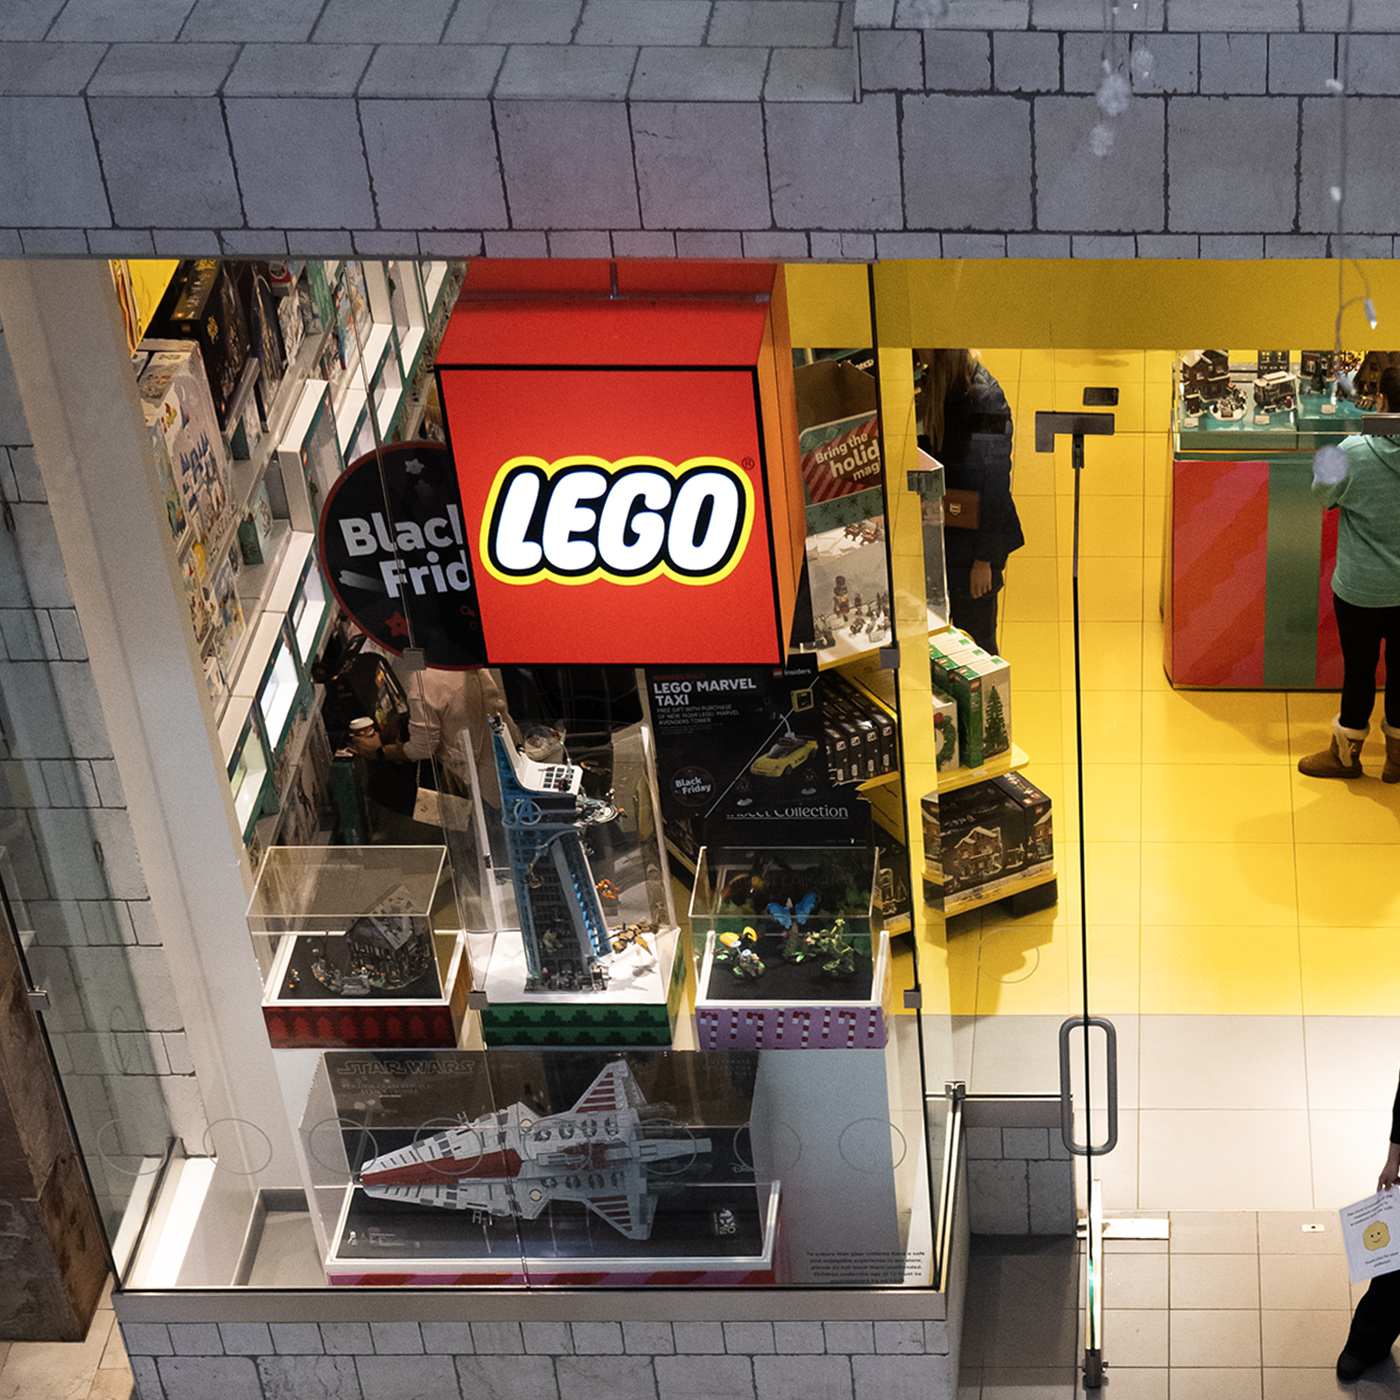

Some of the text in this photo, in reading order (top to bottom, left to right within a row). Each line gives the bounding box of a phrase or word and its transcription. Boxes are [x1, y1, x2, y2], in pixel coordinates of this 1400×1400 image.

[815, 432, 868, 465] Bring the
[490, 466, 745, 576] LEGO
[784, 668, 811, 676] Insiders
[653, 678, 756, 694] LEGO MARVEL
[655, 694, 689, 707] TAXI
[675, 777, 702, 788] Black
[682, 783, 711, 795] Friday
[774, 803, 848, 818] Collection
[337, 1060, 475, 1075] STAR WARS
